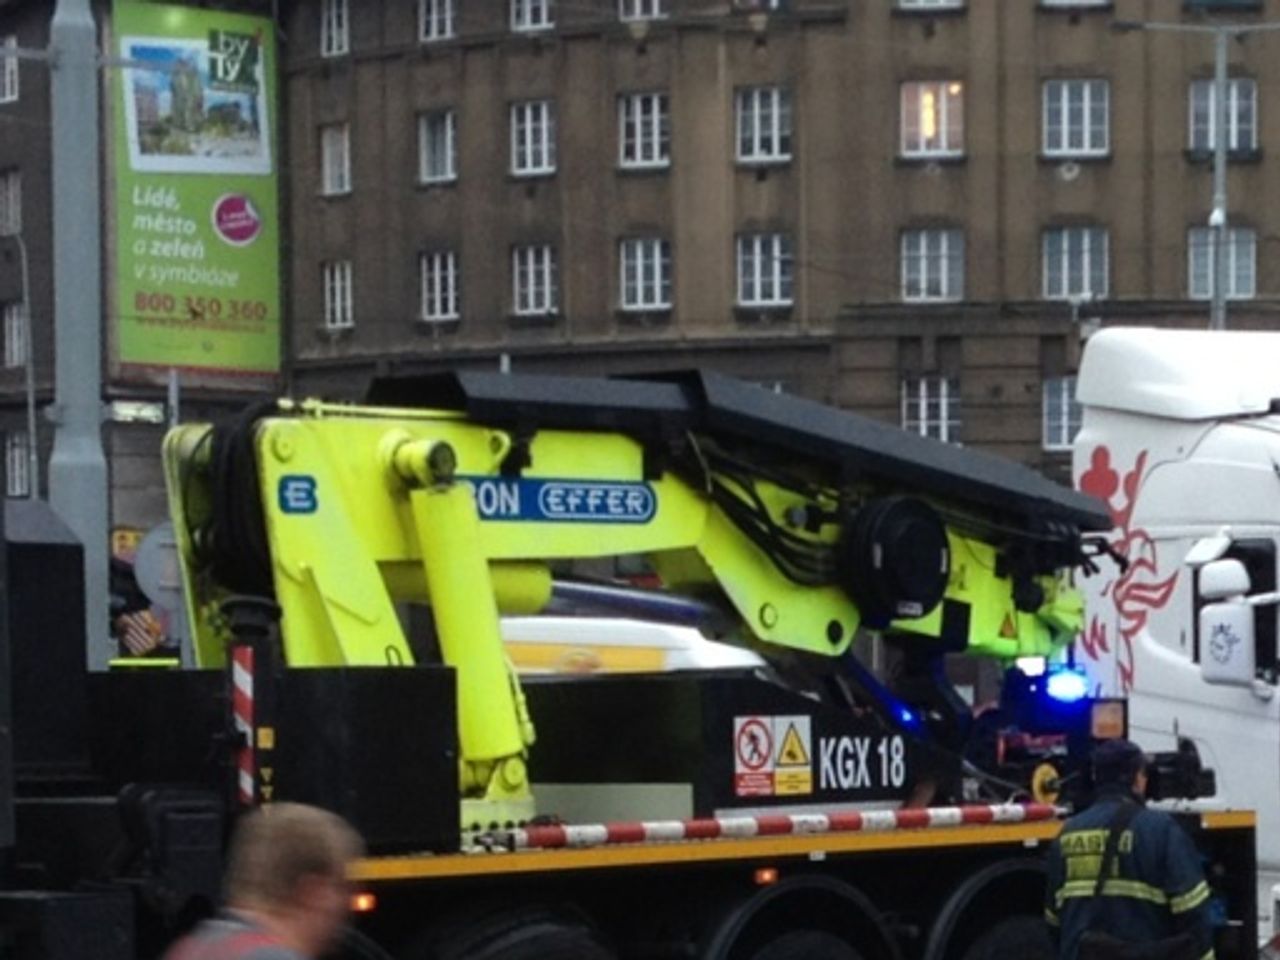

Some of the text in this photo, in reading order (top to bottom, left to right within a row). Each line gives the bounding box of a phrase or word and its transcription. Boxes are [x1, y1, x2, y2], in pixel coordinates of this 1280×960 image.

[545, 488, 645, 514] EFFER
[819, 737, 871, 789] KGX
[878, 735, 905, 787] 18
